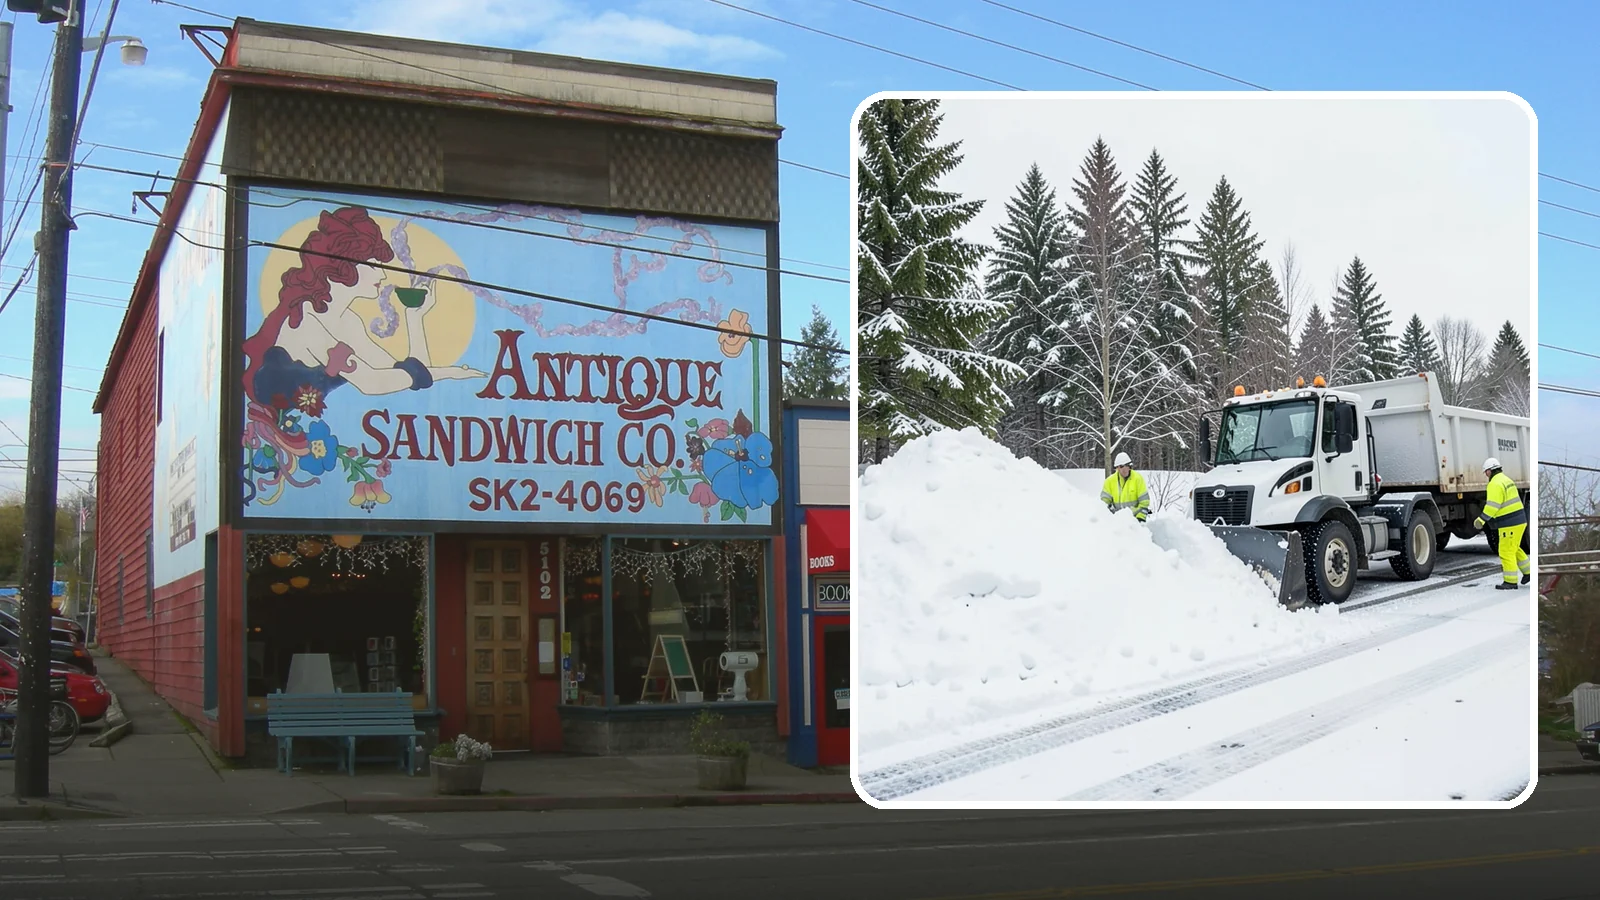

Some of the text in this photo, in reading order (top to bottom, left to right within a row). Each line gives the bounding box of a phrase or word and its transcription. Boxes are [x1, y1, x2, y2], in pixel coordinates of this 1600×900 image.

[476, 329, 724, 421] ANTIQUE
[361, 408, 685, 468] SANDWICH CO.
[467, 477, 646, 513] SK2-4069
[540, 541, 551, 600] 5102
[809, 555, 835, 569] BOOKS
